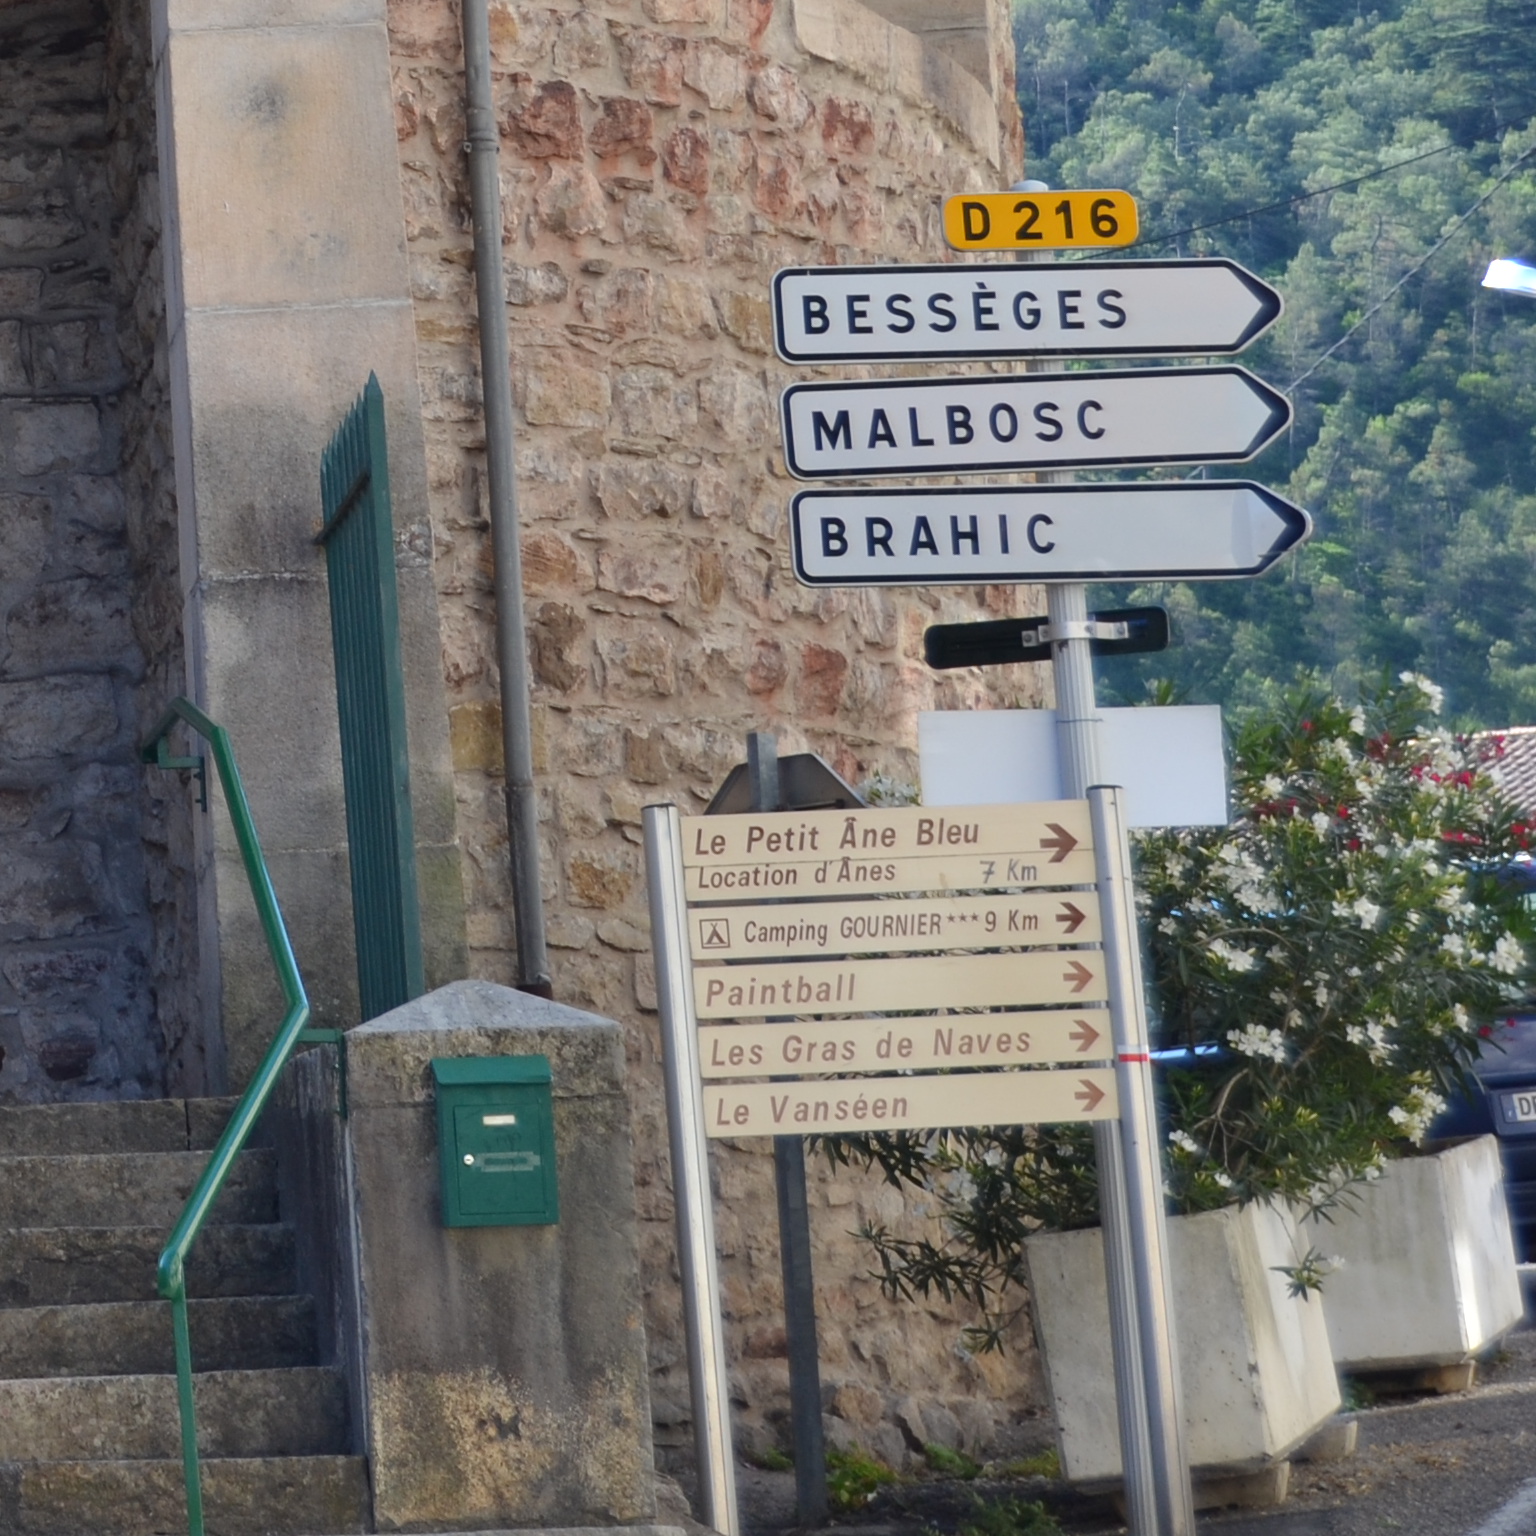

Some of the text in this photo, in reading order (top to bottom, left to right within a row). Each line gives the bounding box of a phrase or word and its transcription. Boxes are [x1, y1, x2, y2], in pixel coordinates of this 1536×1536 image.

[961, 197, 1120, 242] D 216
[801, 282, 1128, 335] BESSÈGES
[811, 399, 1107, 451] MALBOSC
[819, 512, 1057, 557] BRAHIC
[695, 816, 979, 856] Le Petit Âne Bleu
[698, 863, 798, 889] Location
[979, 860, 996, 884] 7
[1006, 857, 1038, 882] Km
[744, 909, 1039, 947] Camping GOURNIER 9 Km
[706, 972, 855, 1007] Paintball
[711, 1028, 1031, 1066] Les Gras de Naves
[716, 1092, 908, 1126] Le Vanséen
